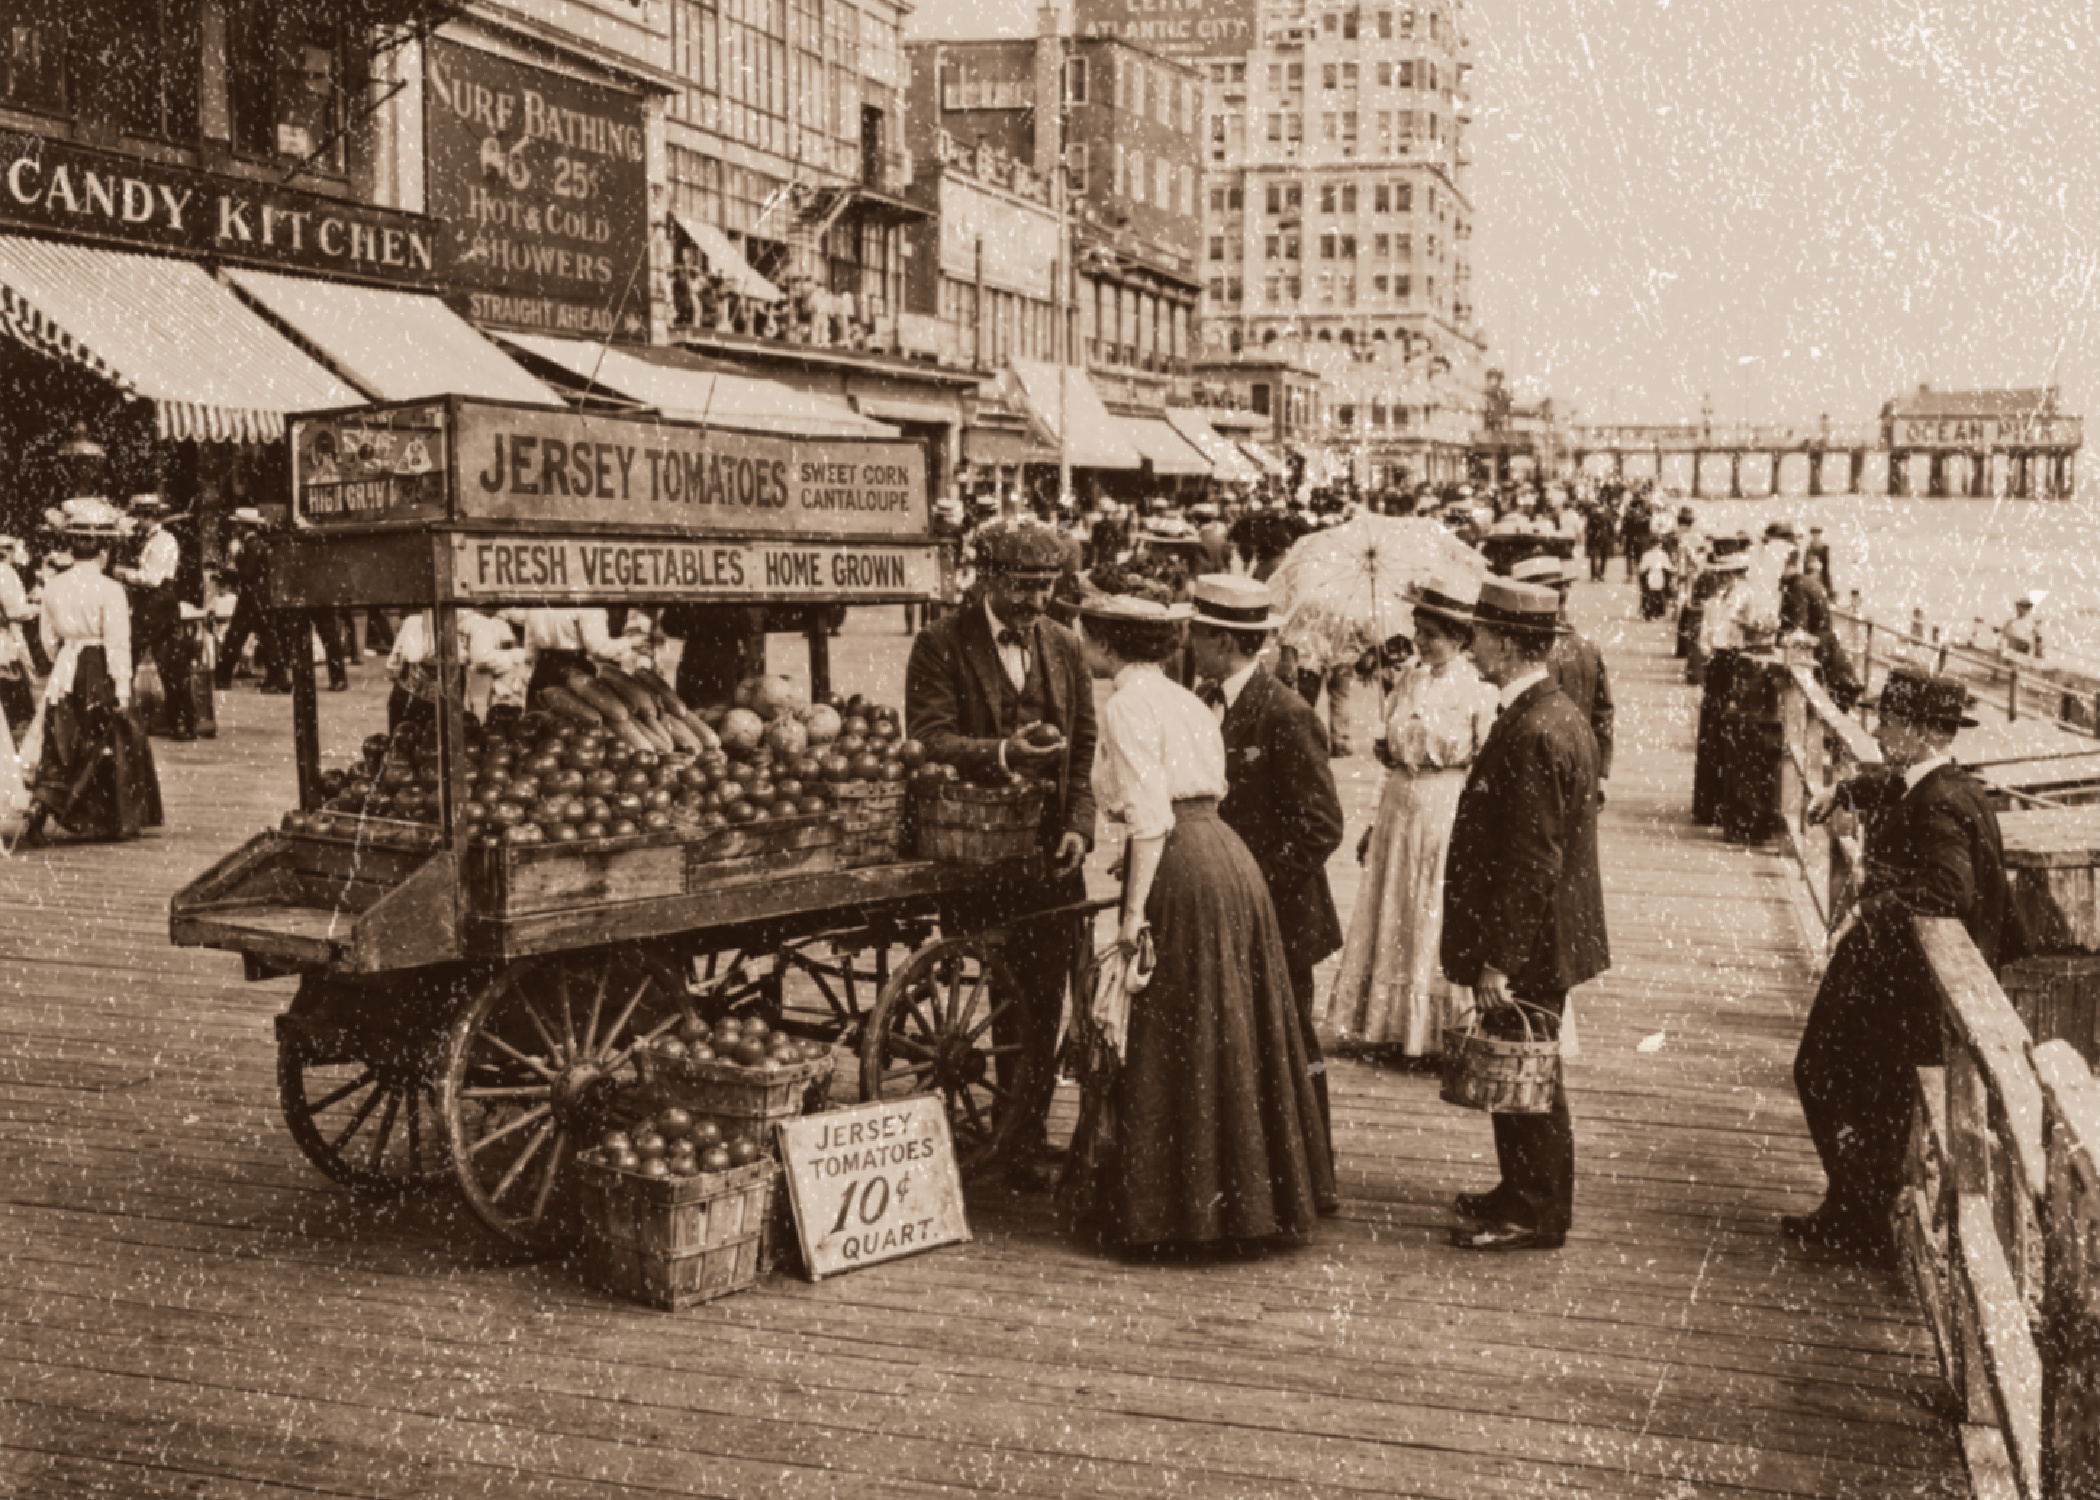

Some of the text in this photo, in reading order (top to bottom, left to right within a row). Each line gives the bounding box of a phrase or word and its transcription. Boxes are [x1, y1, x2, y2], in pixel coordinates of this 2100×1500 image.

[1085, 17, 1247, 39] ATLANTIC CITY
[523, 89, 642, 162] BATHING
[8, 158, 433, 270] CANDY KITCHEN
[545, 204, 611, 243] COLD
[472, 237, 613, 283] SHOWERS
[470, 294, 615, 331] STRAIGHT AHEAD
[1905, 420, 1985, 444] OCEAN
[479, 433, 788, 509] JERSEY TOMATOES
[801, 461, 909, 486] SWEET CORN
[801, 486, 910, 513] CANTALOUPE
[477, 544, 905, 588] FRESH VEGETABLES HOME GROWN
[815, 1112, 912, 1151] JERSEY
[808, 1137, 935, 1180] TOMATOES
[842, 1217, 939, 1261] QUART.
